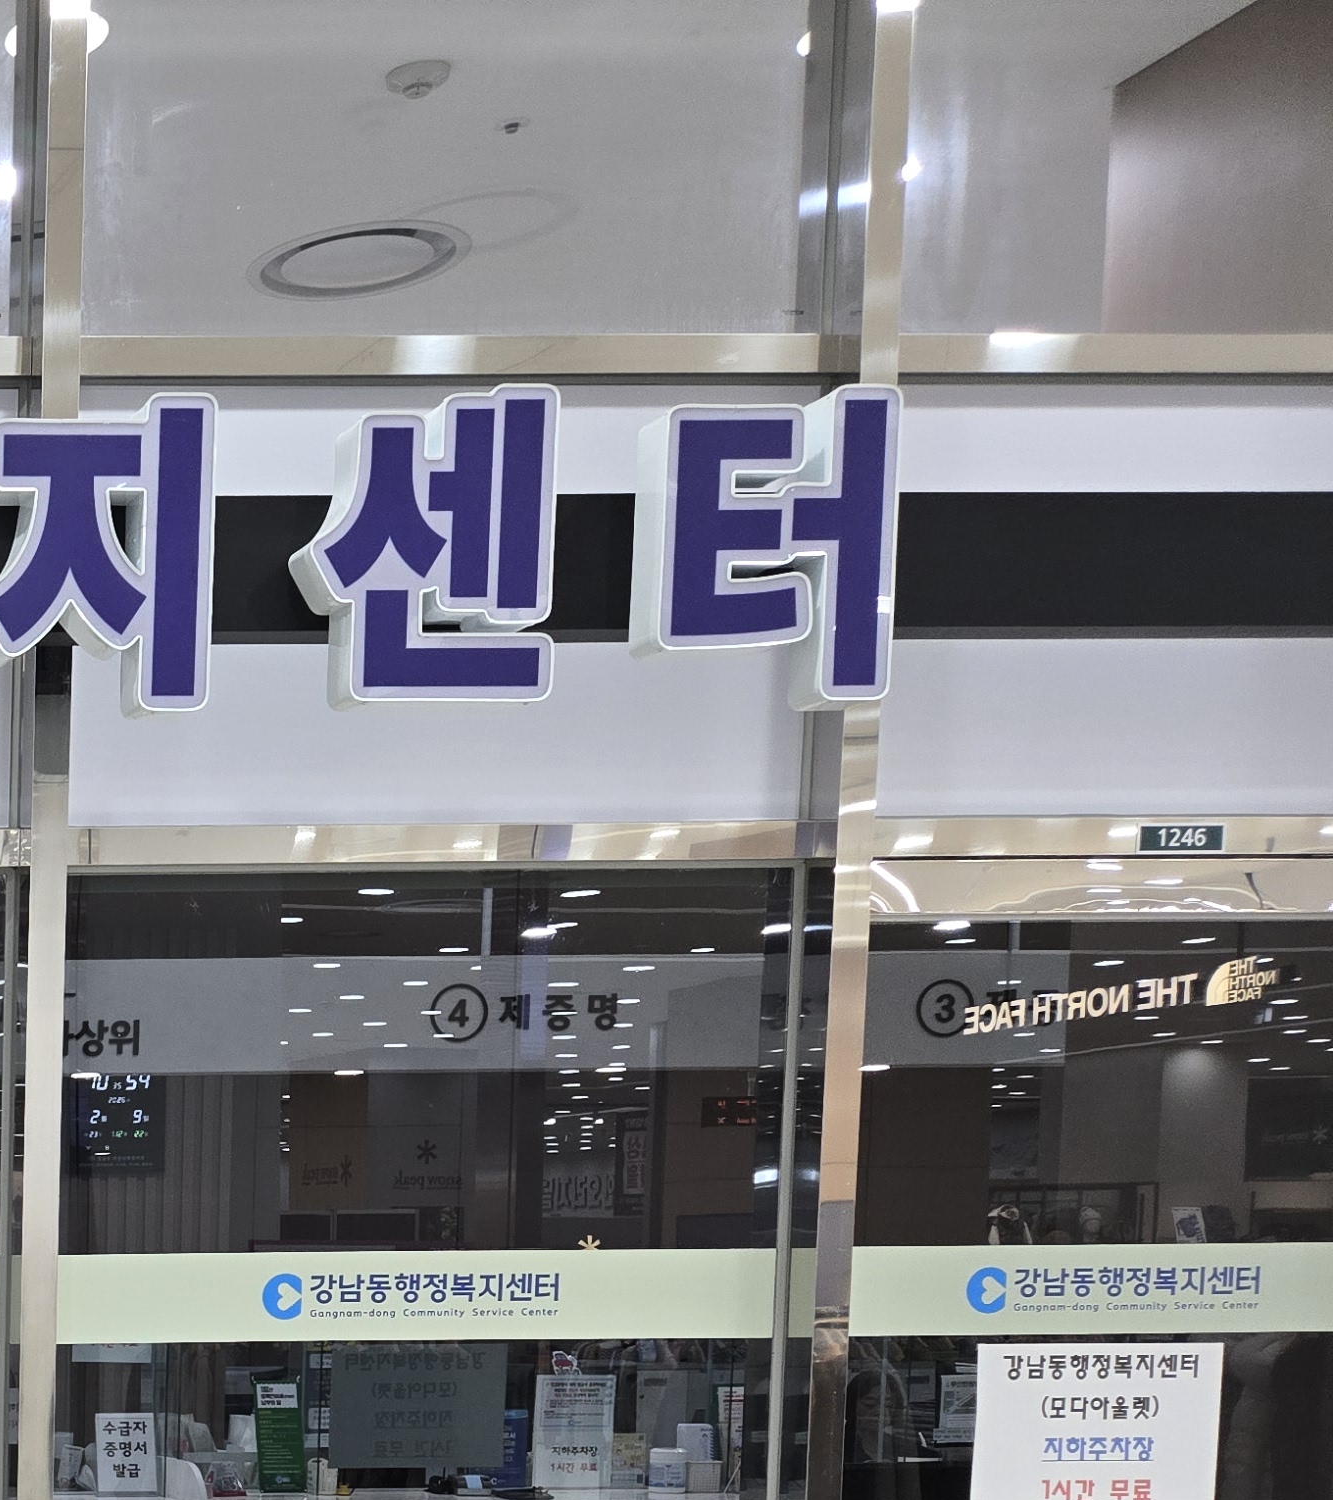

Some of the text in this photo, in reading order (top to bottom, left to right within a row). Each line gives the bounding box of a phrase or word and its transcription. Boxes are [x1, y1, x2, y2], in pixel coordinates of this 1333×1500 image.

[1158, 827, 1207, 846] 1246
[310, 1273, 559, 1304] 강남동행정복지센터
[1015, 1266, 1260, 1297] 강남동행정복지센터
[310, 1308, 558, 1319] Gangnam-dong Community Service Center
[1014, 1301, 1259, 1312] Gangnam-dong Community Service Center
[1004, 1355, 1199, 1380] 강남동행정복지센터
[1042, 1396, 1158, 1419] (모다아울렛)
[102, 1420, 147, 1436] 수급자
[103, 1441, 148, 1457] 증명서
[1043, 1435, 1155, 1461] 지하주차장
[112, 1463, 141, 1479] 발급
